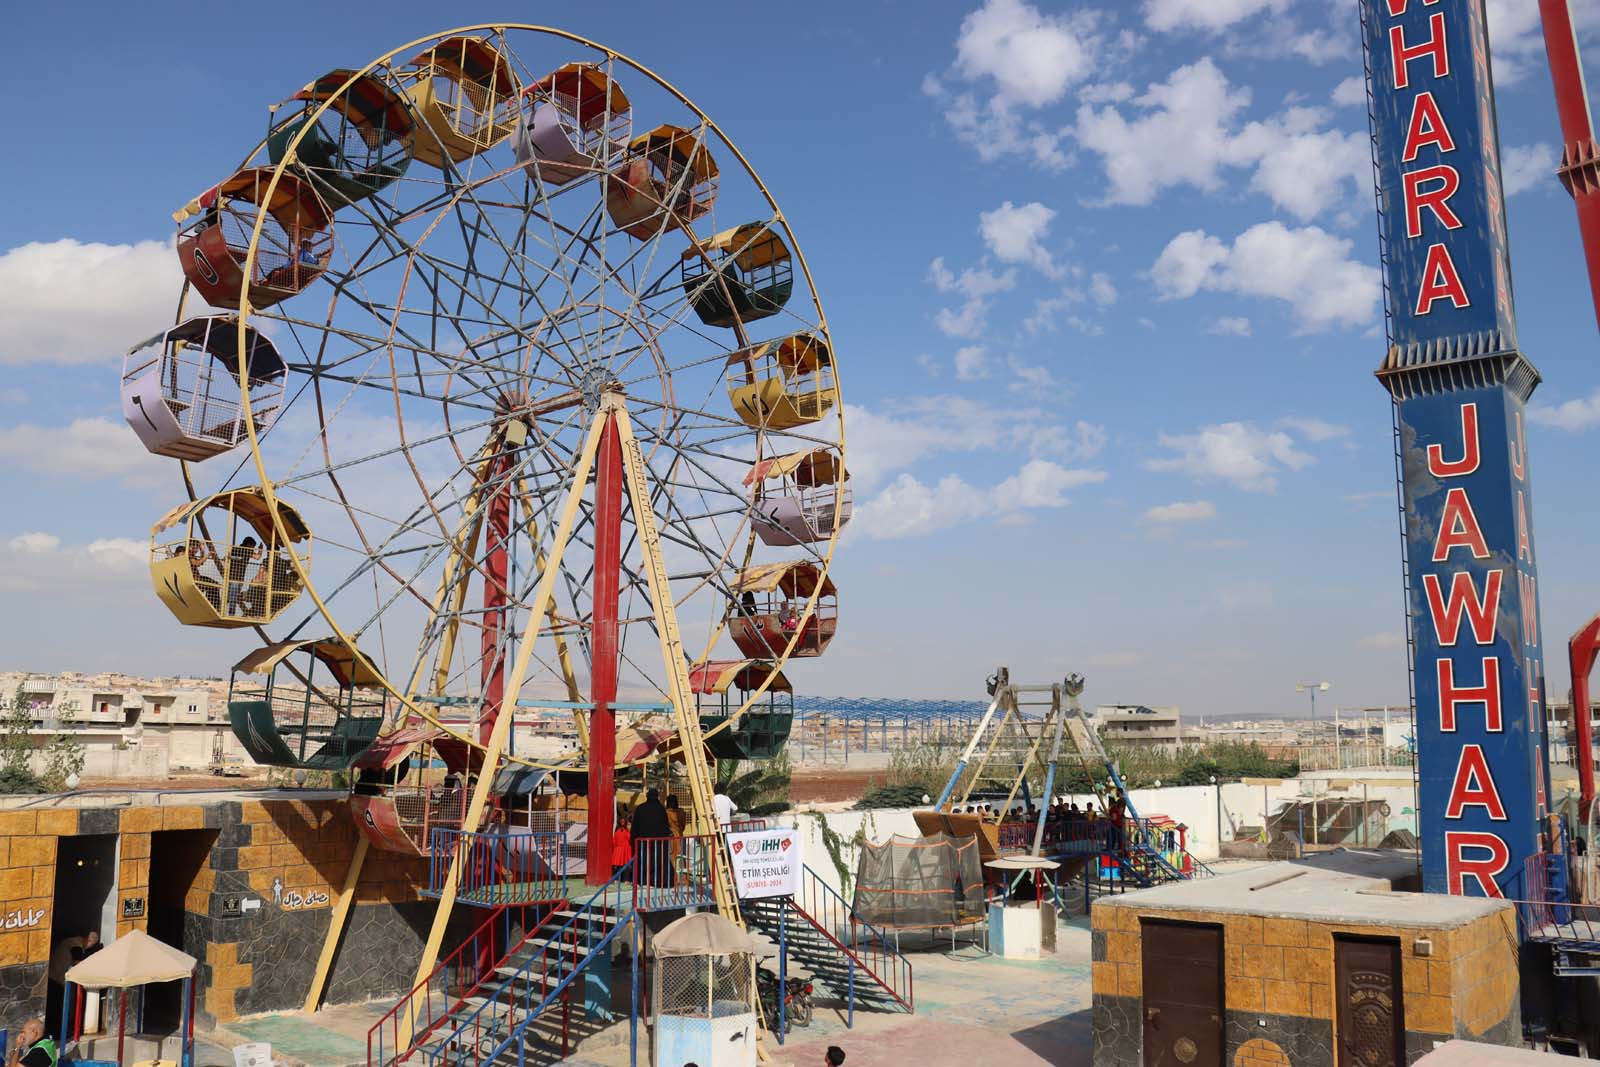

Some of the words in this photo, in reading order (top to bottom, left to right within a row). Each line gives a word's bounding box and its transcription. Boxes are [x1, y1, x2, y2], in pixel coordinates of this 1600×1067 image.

[1385, 0, 1471, 316] HARA
[740, 867, 761, 878] ETİM
[5, 908, 45, 929] حمامات
